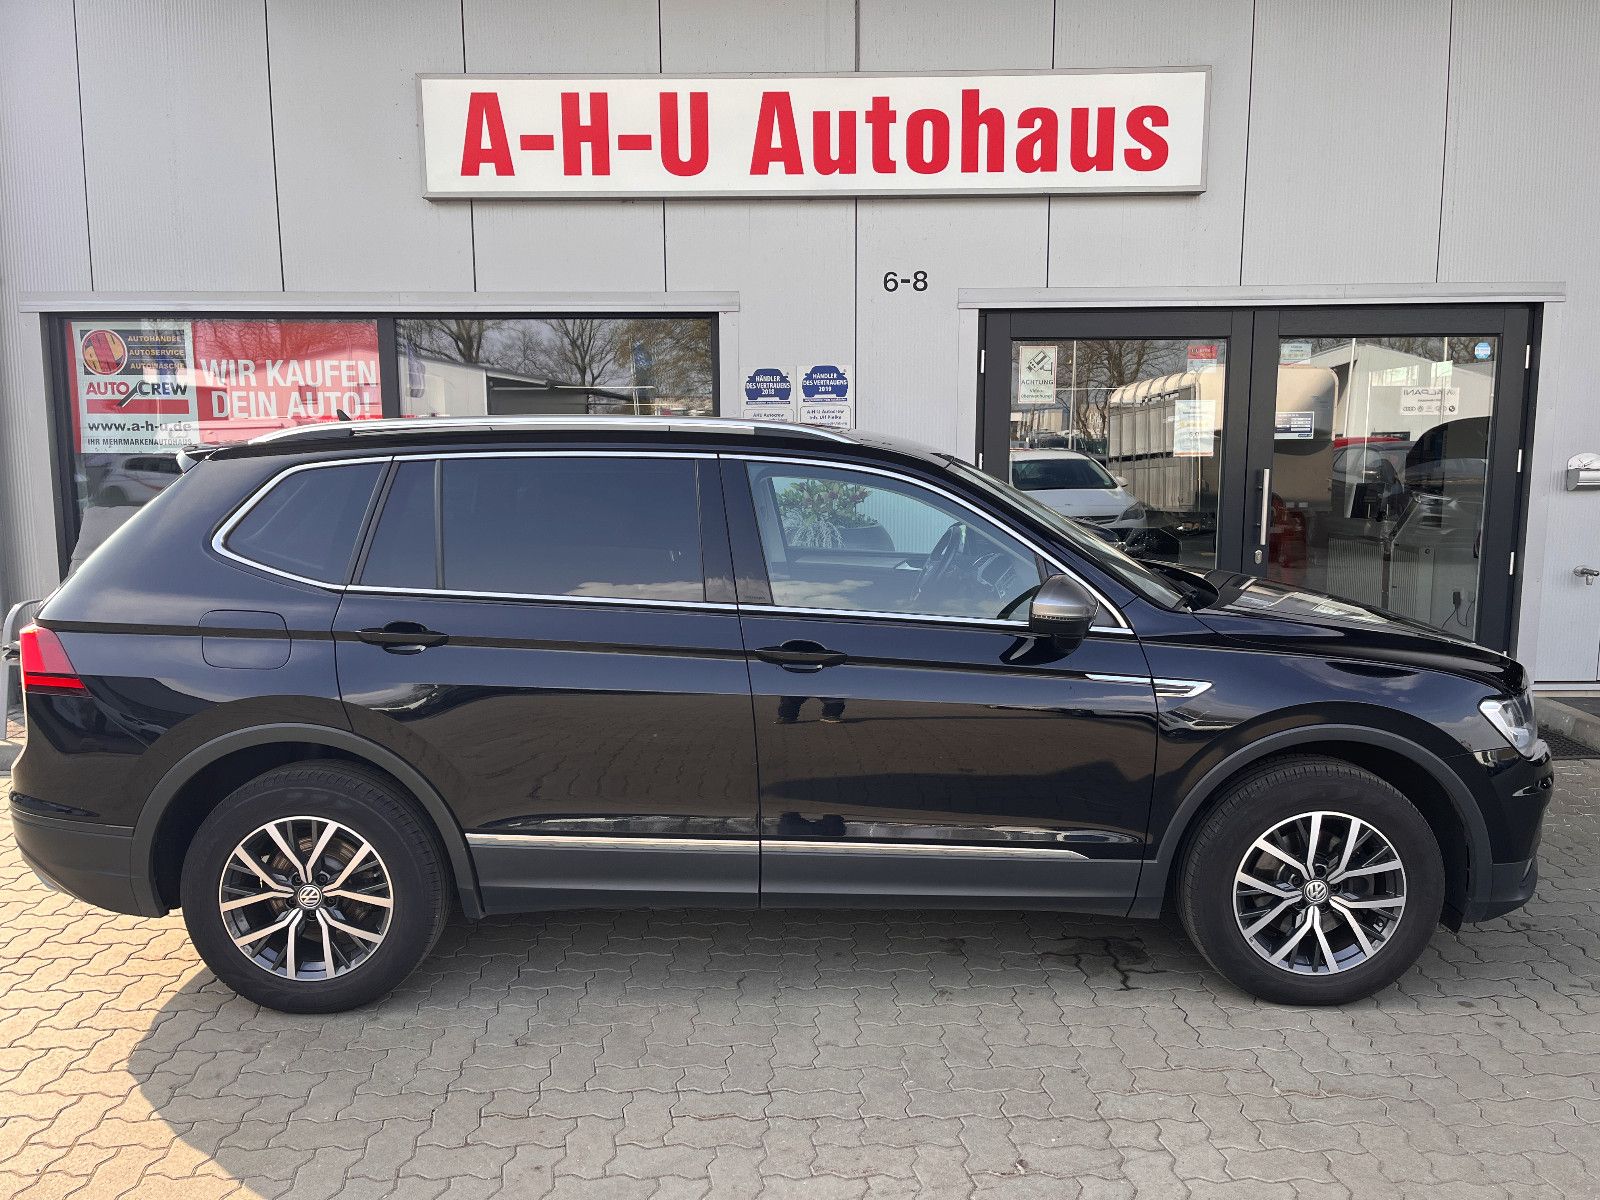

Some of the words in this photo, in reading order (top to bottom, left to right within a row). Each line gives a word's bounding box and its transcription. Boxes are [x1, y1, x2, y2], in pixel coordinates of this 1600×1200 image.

[460, 91, 709, 177] A-H-U
[749, 88, 1169, 175] Autohaus
[883, 270, 928, 292] 6-8
[200, 359, 257, 387] WIR
[265, 359, 377, 387] KAUFEN
[86, 381, 130, 396] AUTO
[138, 381, 188, 396] CREW
[211, 391, 278, 418] DEIN
[287, 391, 371, 418] AUTO!
[88, 421, 192, 431] www.a-h-u.de
[102, 438, 193, 446] MEHRMARKENAUTOHAUS
